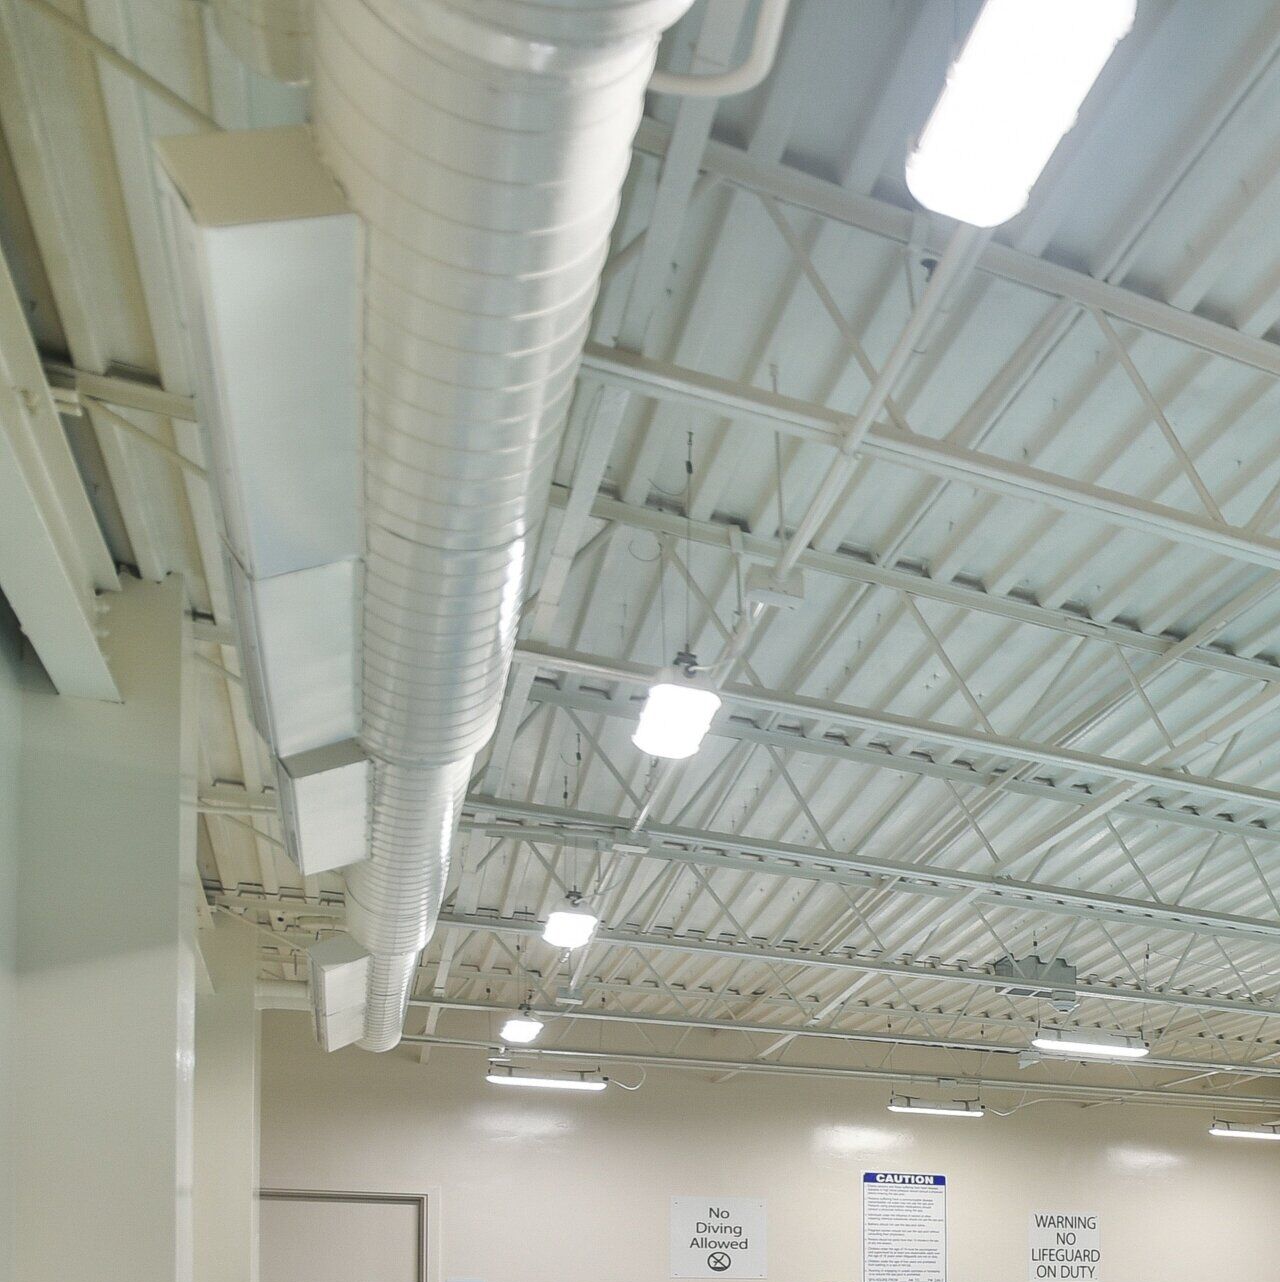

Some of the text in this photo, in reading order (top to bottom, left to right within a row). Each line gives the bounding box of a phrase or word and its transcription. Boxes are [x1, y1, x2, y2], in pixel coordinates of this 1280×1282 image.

[876, 1174, 934, 1184] CAUTION
[709, 1207, 730, 1219] No
[1035, 1214, 1096, 1229] WARNING
[696, 1222, 742, 1237] Diving
[690, 1237, 748, 1249] Allowed
[1057, 1232, 1076, 1245] NO
[1032, 1248, 1100, 1262] LIFEGUARD
[1037, 1265, 1095, 1279] ON DUTY
